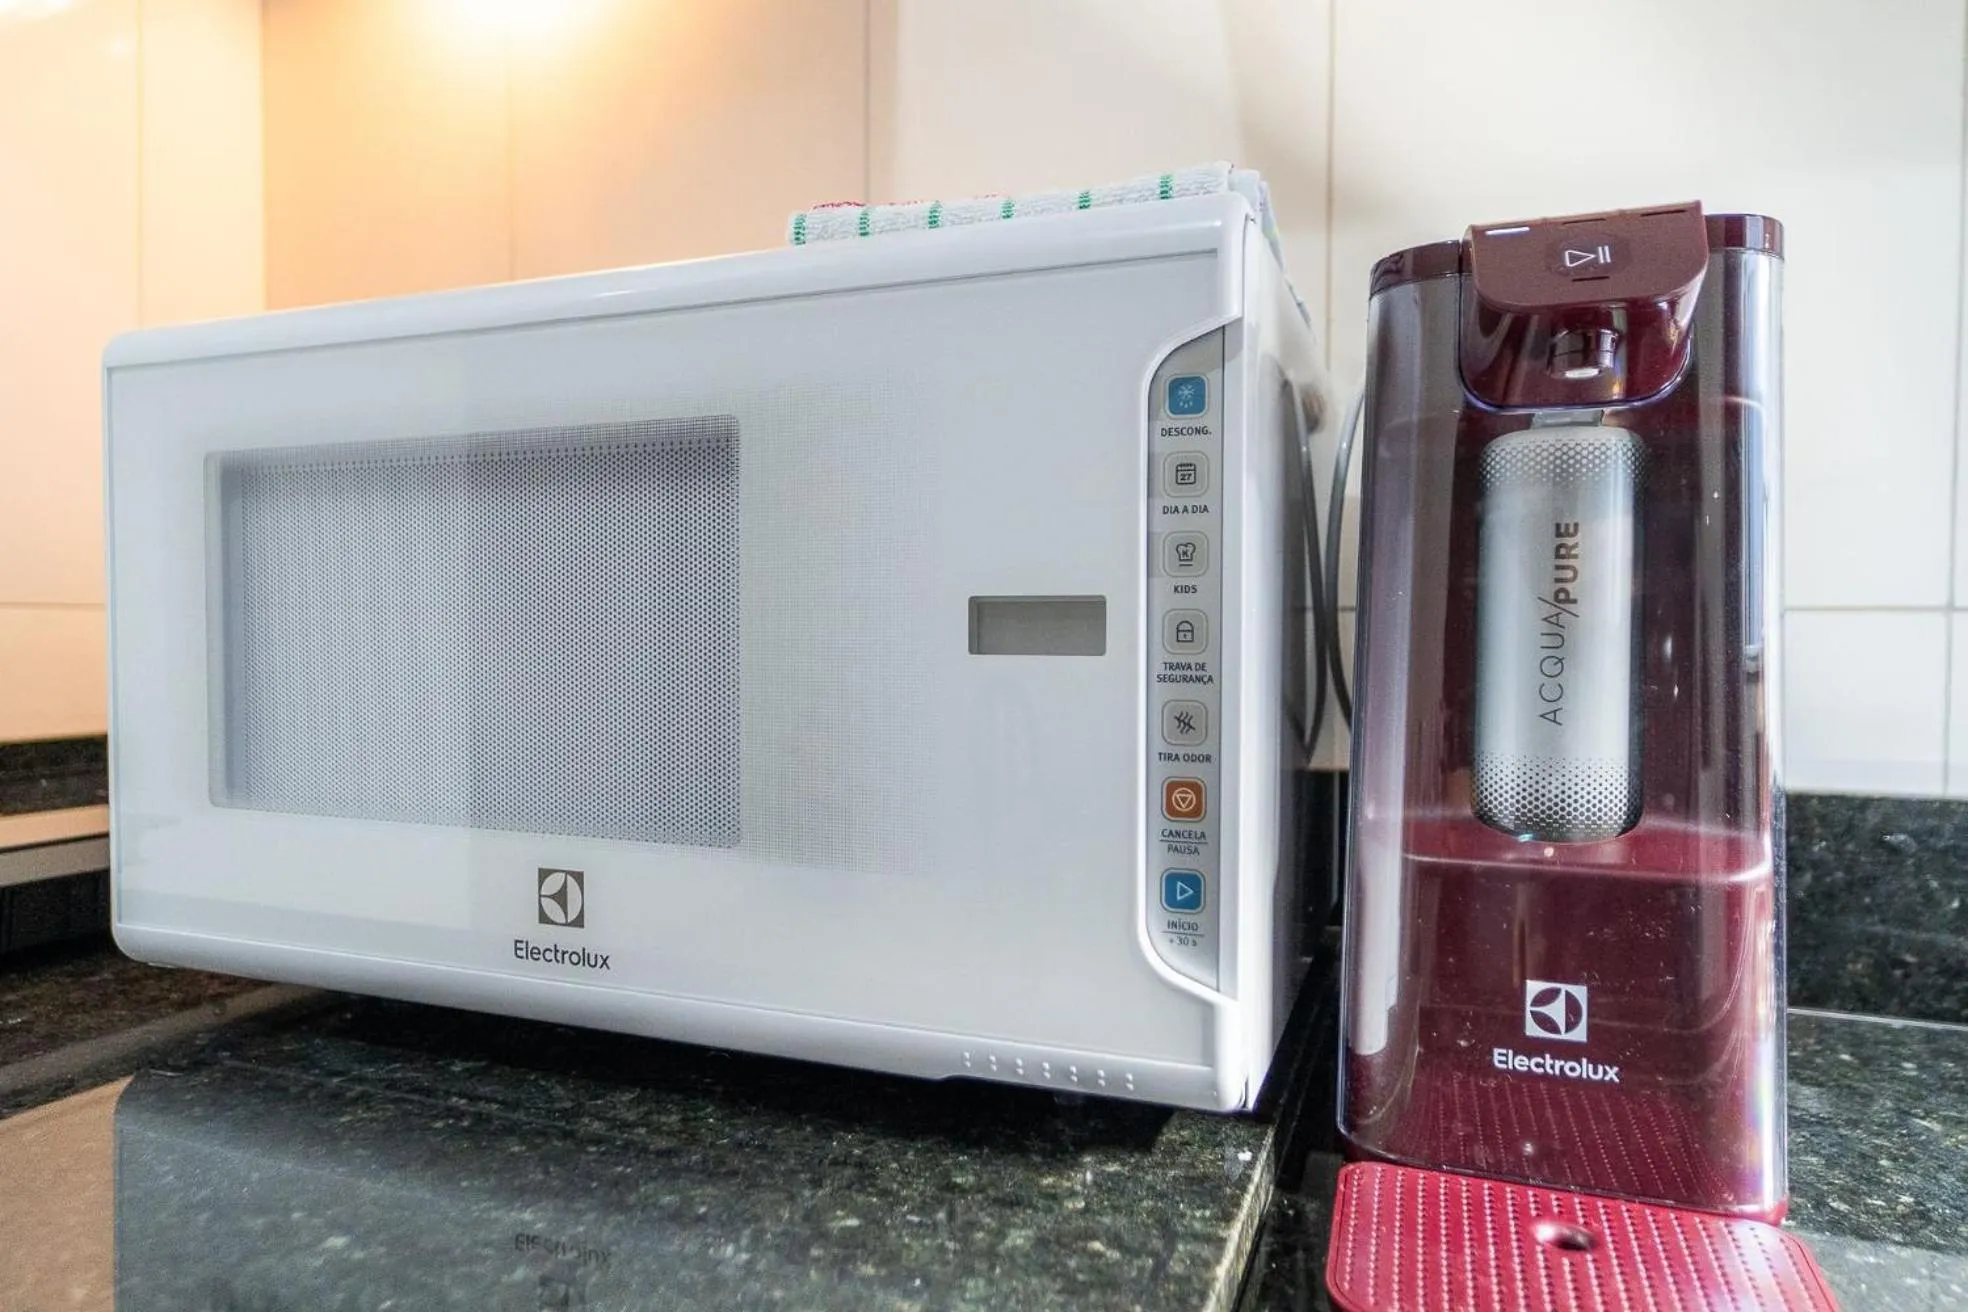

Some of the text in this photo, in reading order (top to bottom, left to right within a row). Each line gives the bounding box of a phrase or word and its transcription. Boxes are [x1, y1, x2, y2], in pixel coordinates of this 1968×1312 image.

[1160, 426, 1212, 437] DESCONG.
[1180, 473, 1192, 481] 27
[1162, 505, 1209, 515] DIA A DIA
[1173, 584, 1198, 594] KIDS
[1163, 662, 1207, 672] TRAVA DE
[1156, 673, 1213, 685] SEGURANÇA
[1158, 752, 1212, 763] TIRA ODOR
[1161, 828, 1207, 841] CANCELA
[1167, 843, 1200, 856] PAUSA
[1167, 917, 1199, 931] INÍCIO
[514, 939, 611, 970] Electrolux
[1492, 1047, 1620, 1083] Electrolux
